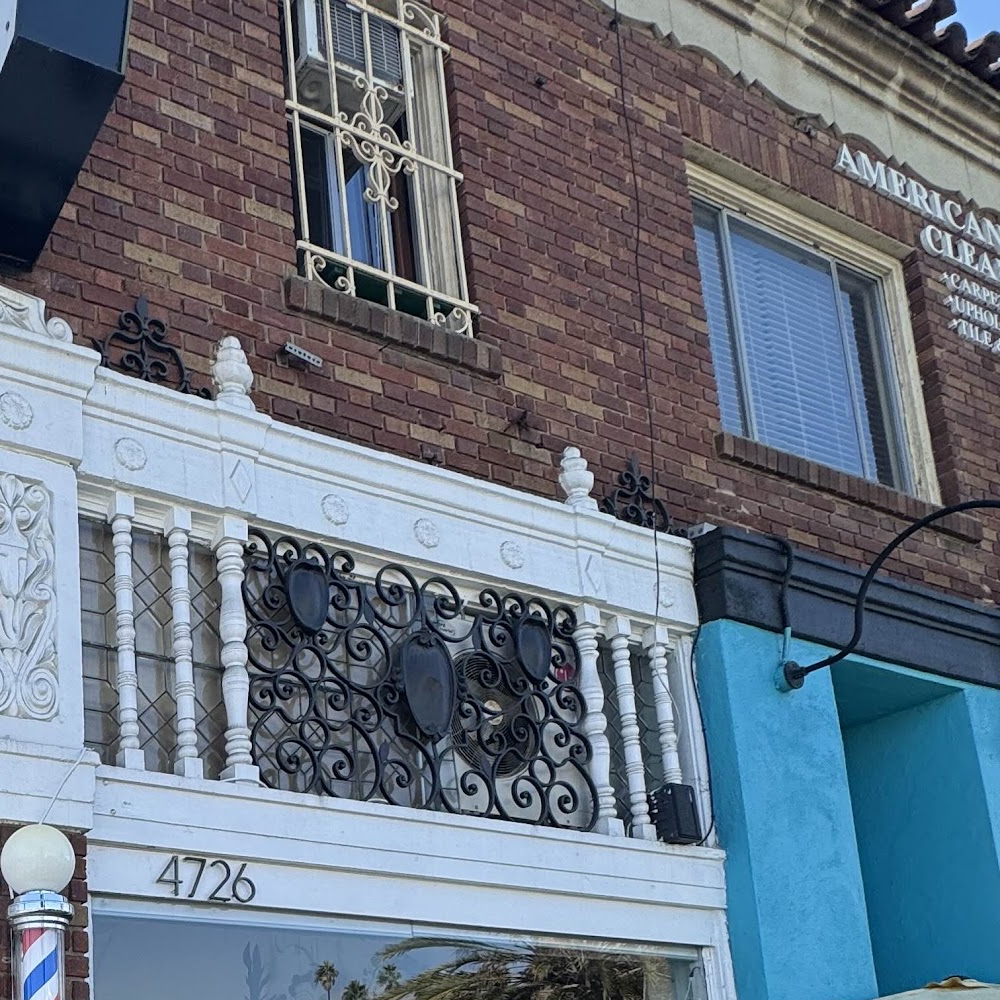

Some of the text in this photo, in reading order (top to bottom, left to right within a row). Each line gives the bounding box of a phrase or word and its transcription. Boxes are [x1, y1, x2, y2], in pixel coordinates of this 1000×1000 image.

[833, 143, 1000, 252] AMERICAN
[919, 224, 1000, 284] CLEA
[156, 855, 256, 903] 4726
